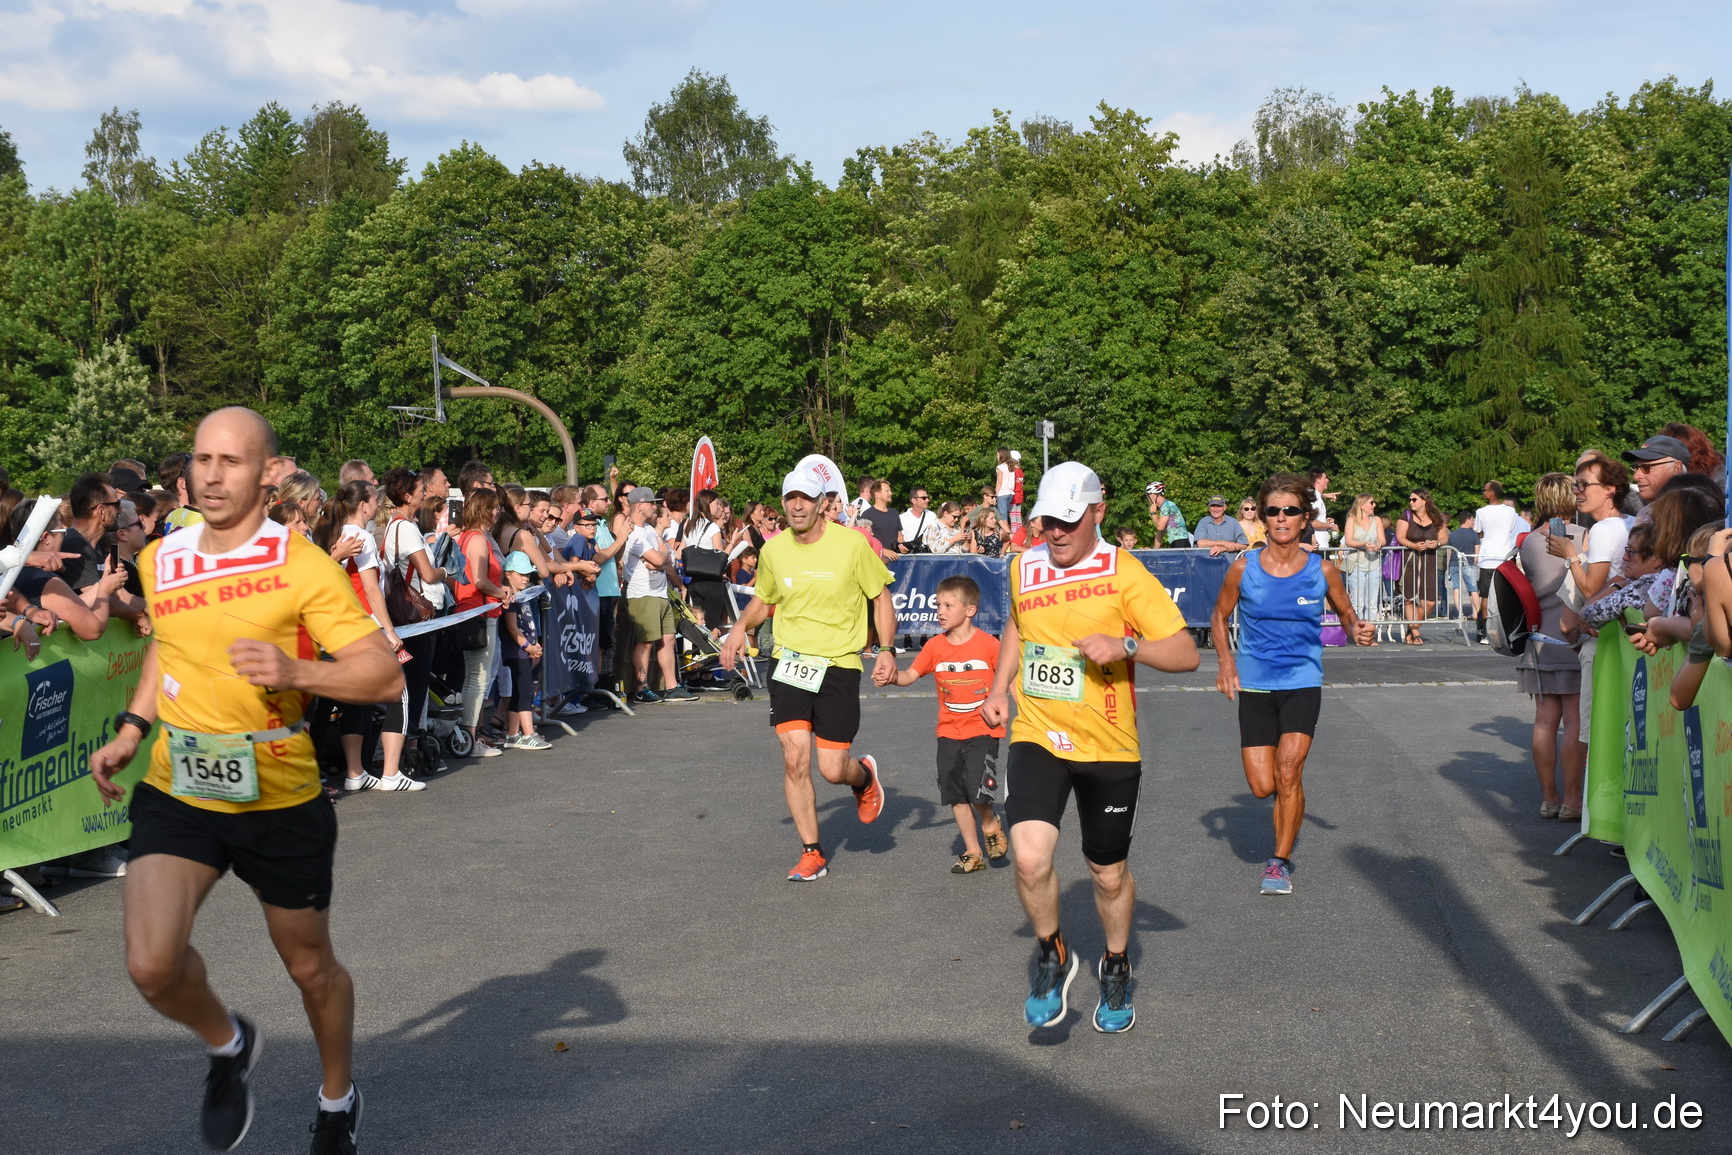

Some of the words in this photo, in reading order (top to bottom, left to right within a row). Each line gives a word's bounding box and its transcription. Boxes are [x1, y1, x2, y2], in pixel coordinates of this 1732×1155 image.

[154, 590, 209, 618] MAX
[218, 574, 290, 602] BÖGL
[1018, 592, 1058, 614] MAX
[1065, 582, 1119, 602] BÖGL
[895, 613, 940, 622] MOBIL
[784, 661, 819, 681] 1197
[1028, 661, 1075, 686] 1683
[35, 690, 67, 712] Fischer
[181, 755, 243, 784] 1548
[2, 795, 53, 832] neumarkt
